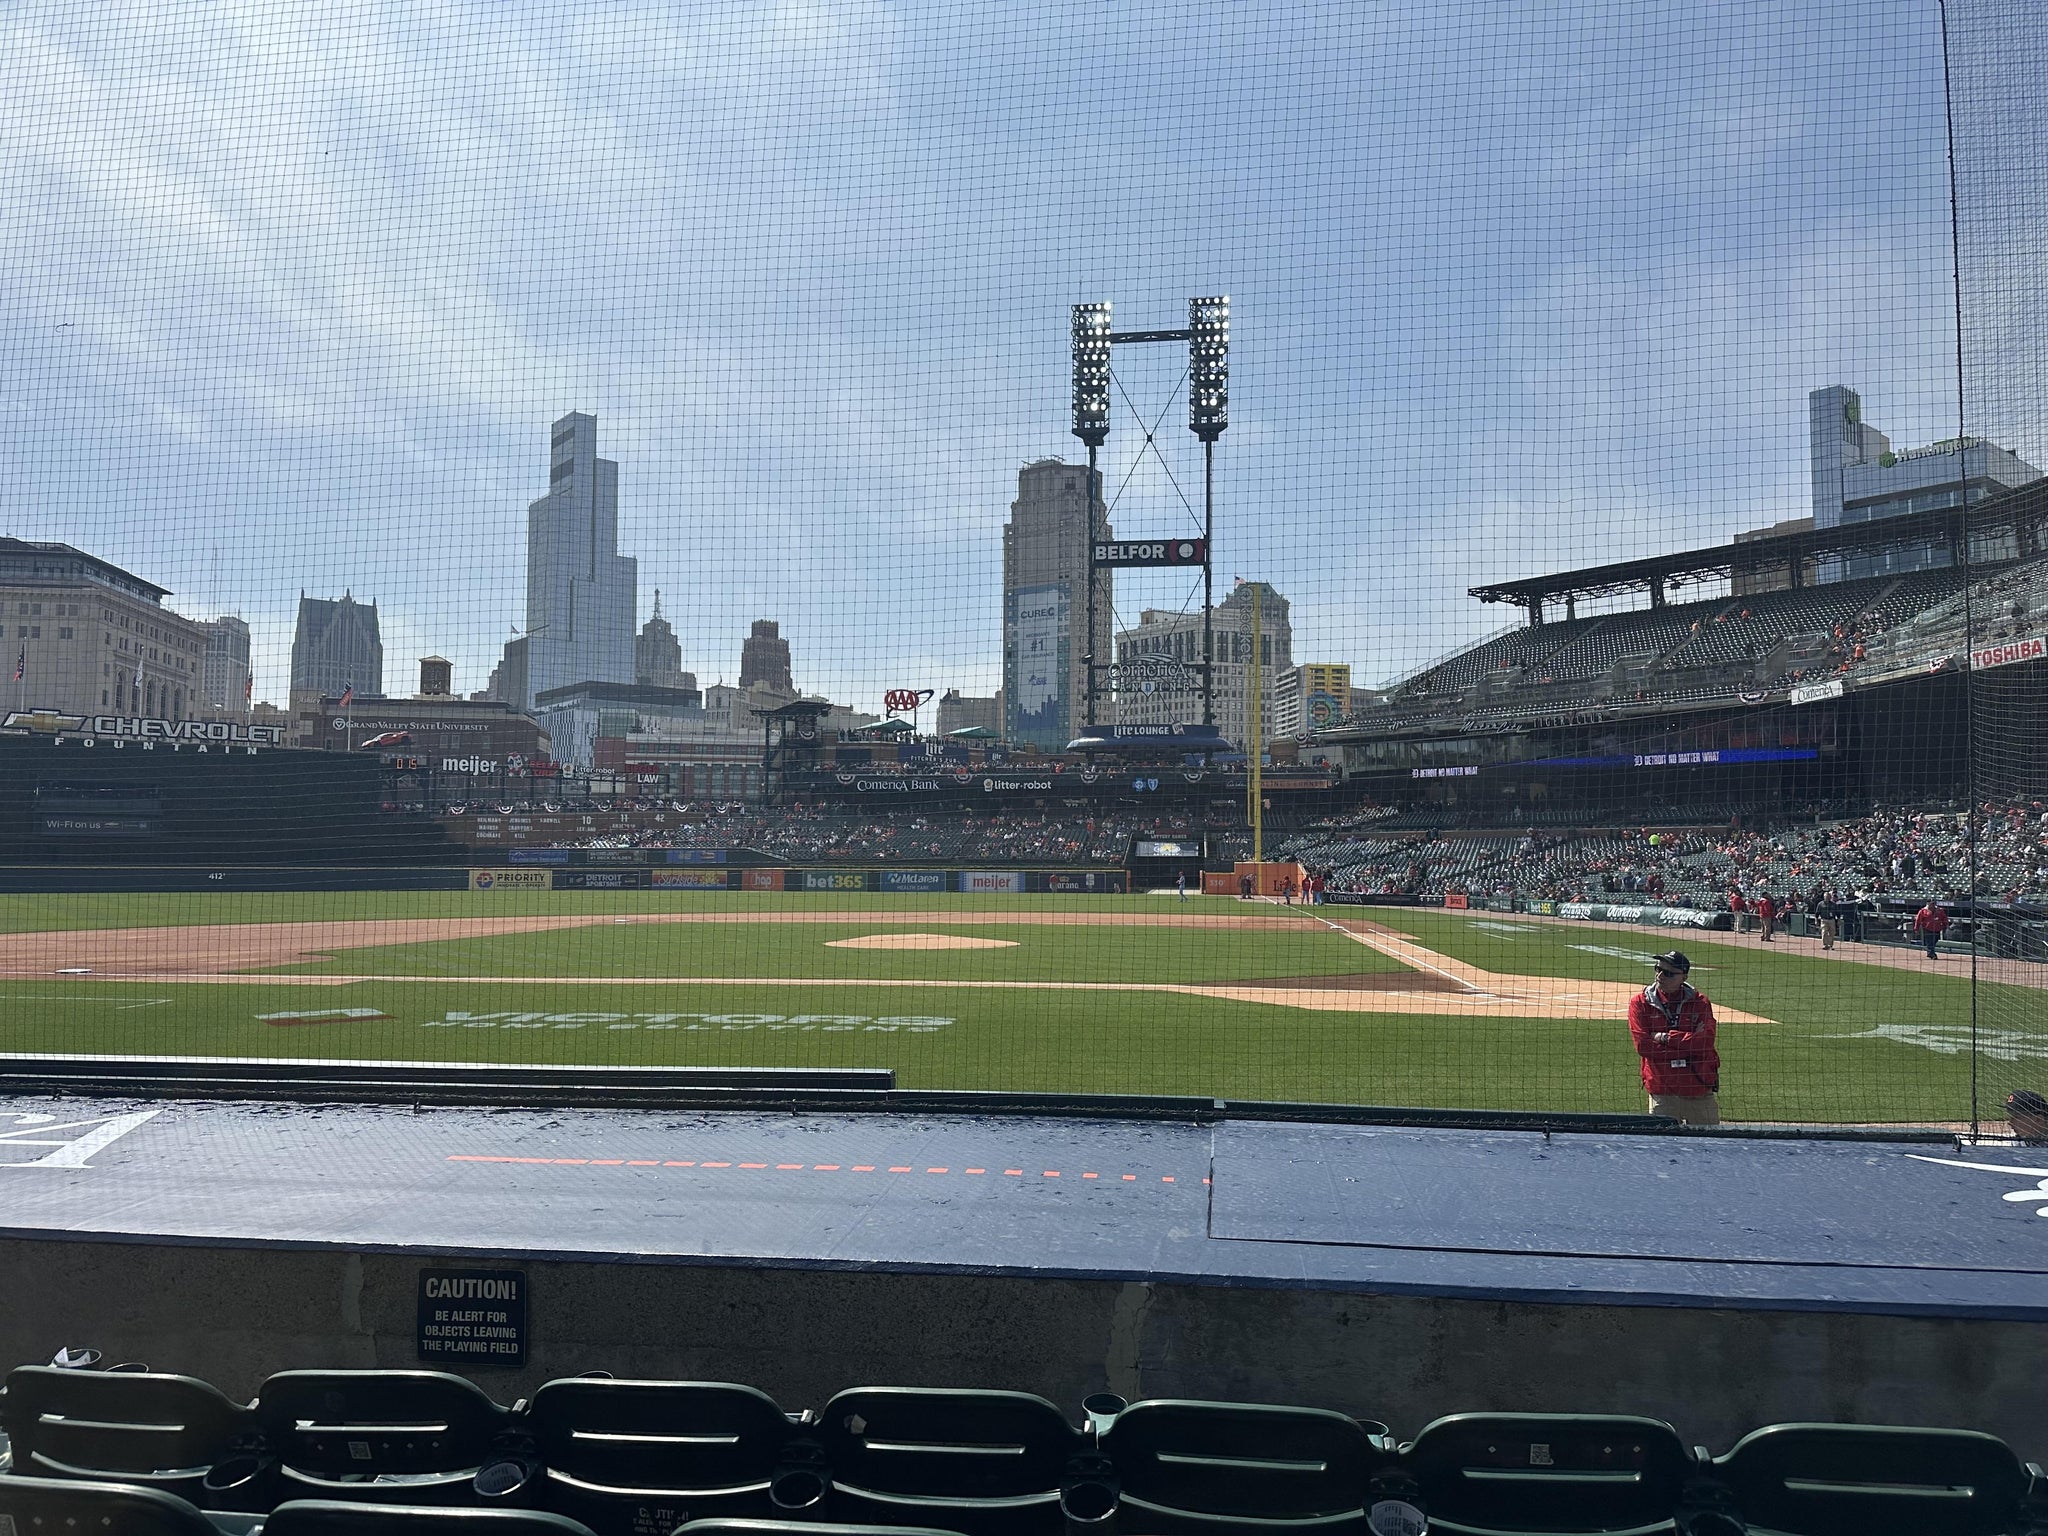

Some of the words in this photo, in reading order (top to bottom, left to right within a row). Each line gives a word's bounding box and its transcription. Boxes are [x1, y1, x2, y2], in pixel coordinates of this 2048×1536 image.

[1898, 438, 1980, 461] Huntington
[1095, 544, 1164, 560] BELFOR
[1973, 640, 2042, 667] TOSHIBA
[888, 691, 914, 710] AAA
[94, 716, 286, 743] CHEVROLET
[346, 721, 378, 729] GRAND
[378, 722, 408, 730] VALLEY
[409, 722, 435, 730] STATE
[436, 721, 489, 731] UNIVERSITY
[1134, 727, 1169, 735] LOUNGE
[54, 737, 257, 754] FOUNTAIN
[442, 755, 497, 776] meijer
[1644, 755, 1666, 766] DETROIT
[1668, 754, 1677, 764] NO
[1678, 752, 1700, 764] MATTER
[1702, 751, 1719, 762] WHAT
[911, 780, 940, 790] Bank
[582, 816, 592, 825] 10
[621, 814, 628, 822] 11
[655, 814, 665, 822] 42
[807, 874, 863, 888] bet365
[973, 876, 1011, 889] meijer
[426, 1278, 517, 1300] CAUTION!
[435, 1310, 449, 1321] BE
[452, 1311, 484, 1322] ALERT
[487, 1312, 507, 1323] FOR
[425, 1325, 471, 1337] OBJECTS
[473, 1326, 517, 1339] LEAVING
[422, 1340, 442, 1351] THE
[445, 1341, 488, 1353] PLAYING
[490, 1342, 519, 1354] FIELD
